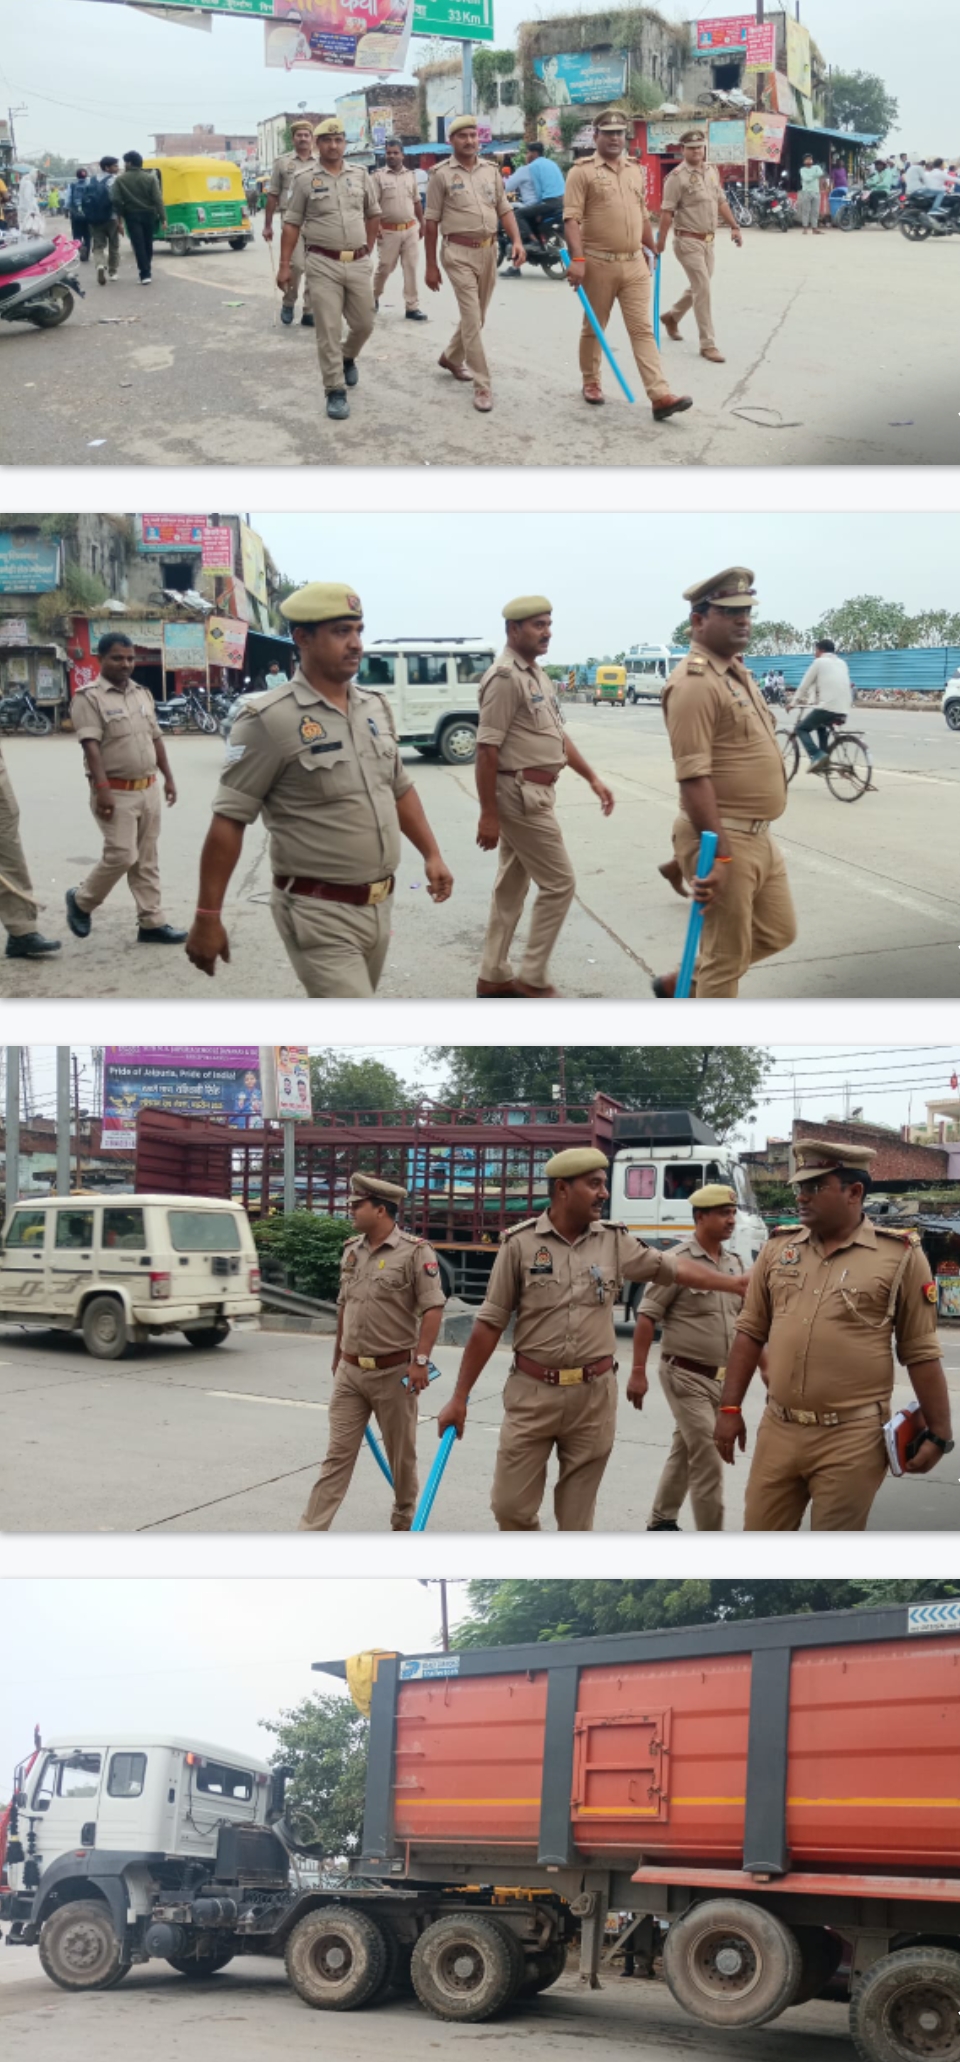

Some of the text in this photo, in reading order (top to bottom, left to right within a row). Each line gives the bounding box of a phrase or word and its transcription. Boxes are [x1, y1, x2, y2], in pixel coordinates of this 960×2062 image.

[463, 11, 481, 24] Km
[109, 1067, 131, 1076] Pride
[132, 1067, 142, 1076] of
[179, 1069, 201, 1078] Pride
[202, 1071, 212, 1079] of
